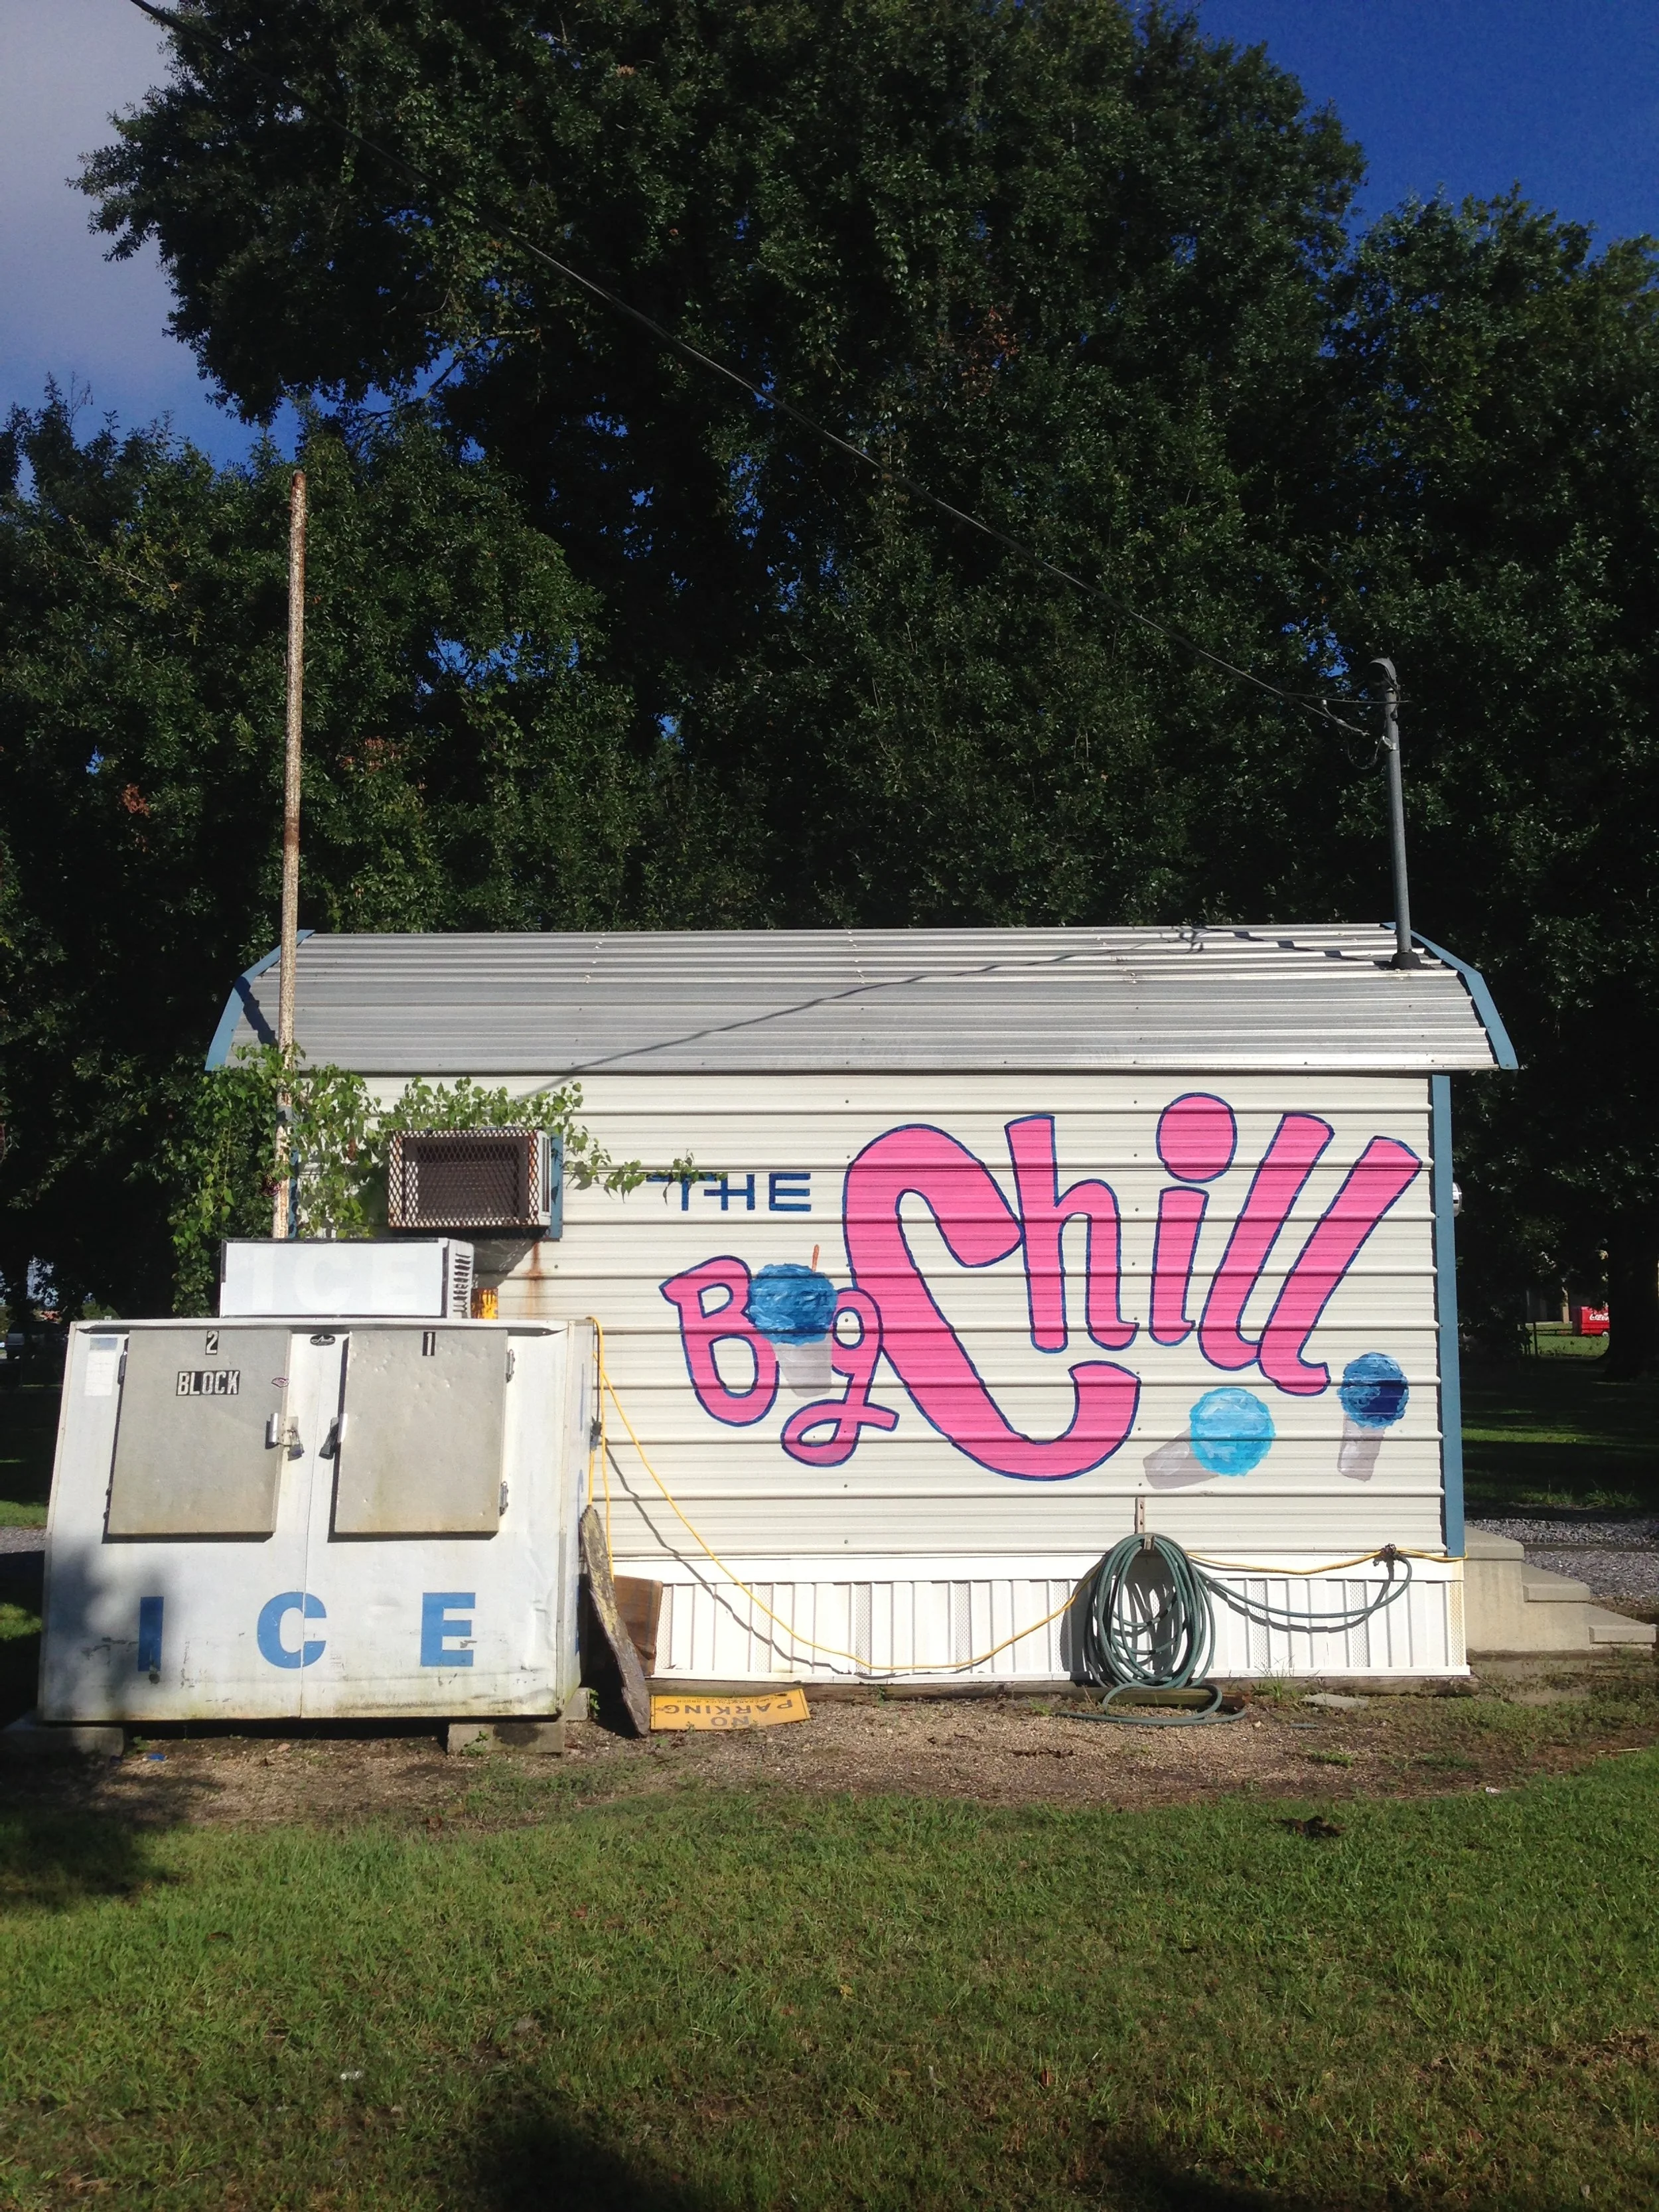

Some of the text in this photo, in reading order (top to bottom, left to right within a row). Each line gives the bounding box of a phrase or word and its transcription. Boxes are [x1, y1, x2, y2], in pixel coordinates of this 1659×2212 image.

[646, 1173, 812, 1211] THE
[252, 1245, 418, 1311] ICE
[842, 1092, 1423, 1481] Chill
[206, 1331, 220, 1355] 2
[425, 1332, 435, 1356] 1
[177, 1370, 240, 1395] BLOCK
[137, 1591, 476, 1672] ICE
[663, 1698, 794, 1715] PARKING
[711, 1715, 750, 1727] NO
